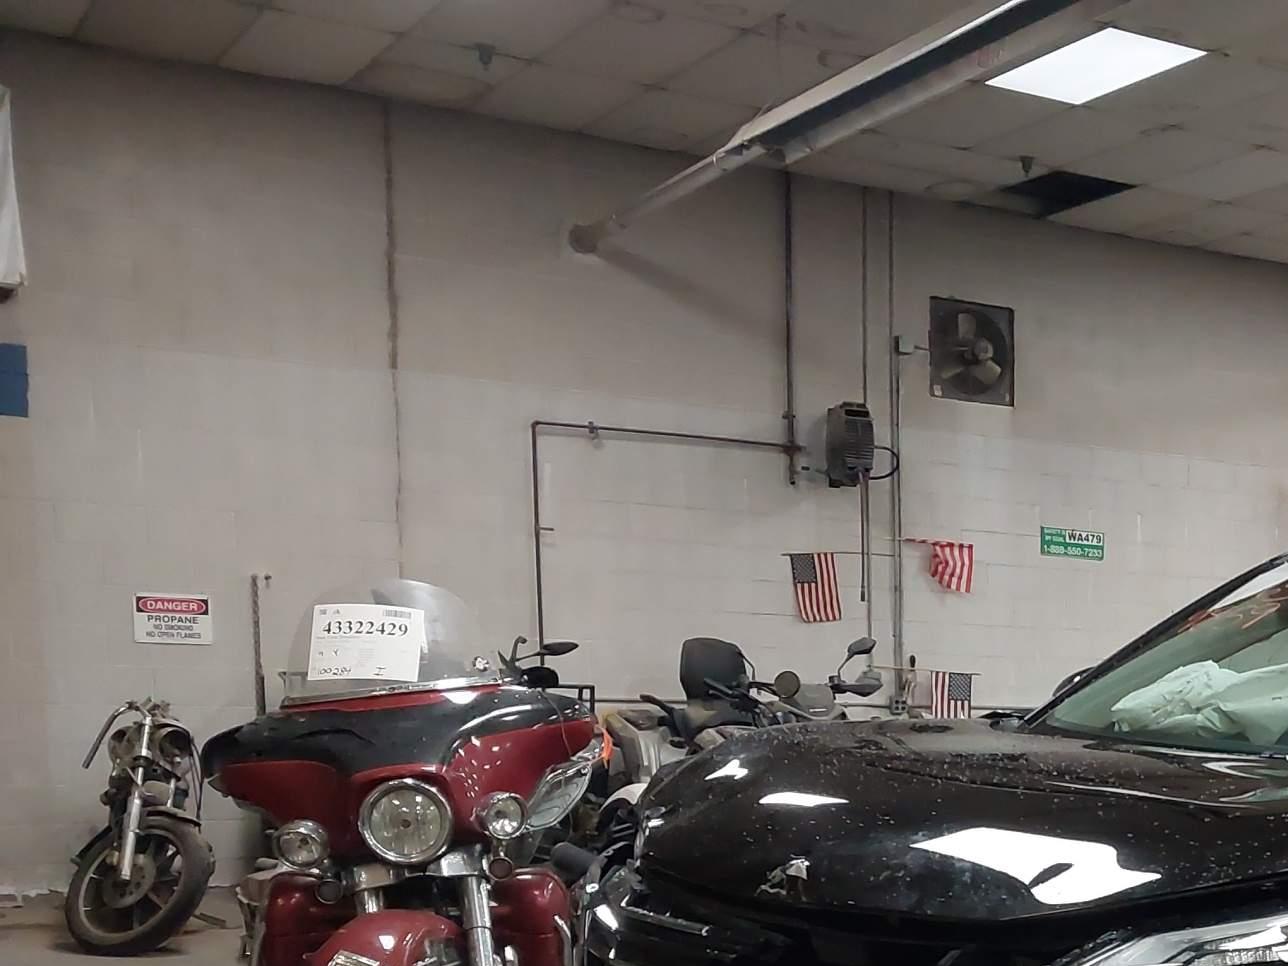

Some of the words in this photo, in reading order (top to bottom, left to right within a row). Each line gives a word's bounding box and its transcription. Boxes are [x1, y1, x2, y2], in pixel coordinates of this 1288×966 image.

[1067, 531, 1102, 544] WA479
[147, 600, 198, 611] DANGER
[147, 615, 200, 624] PROPANE
[322, 620, 409, 637] 43322429
